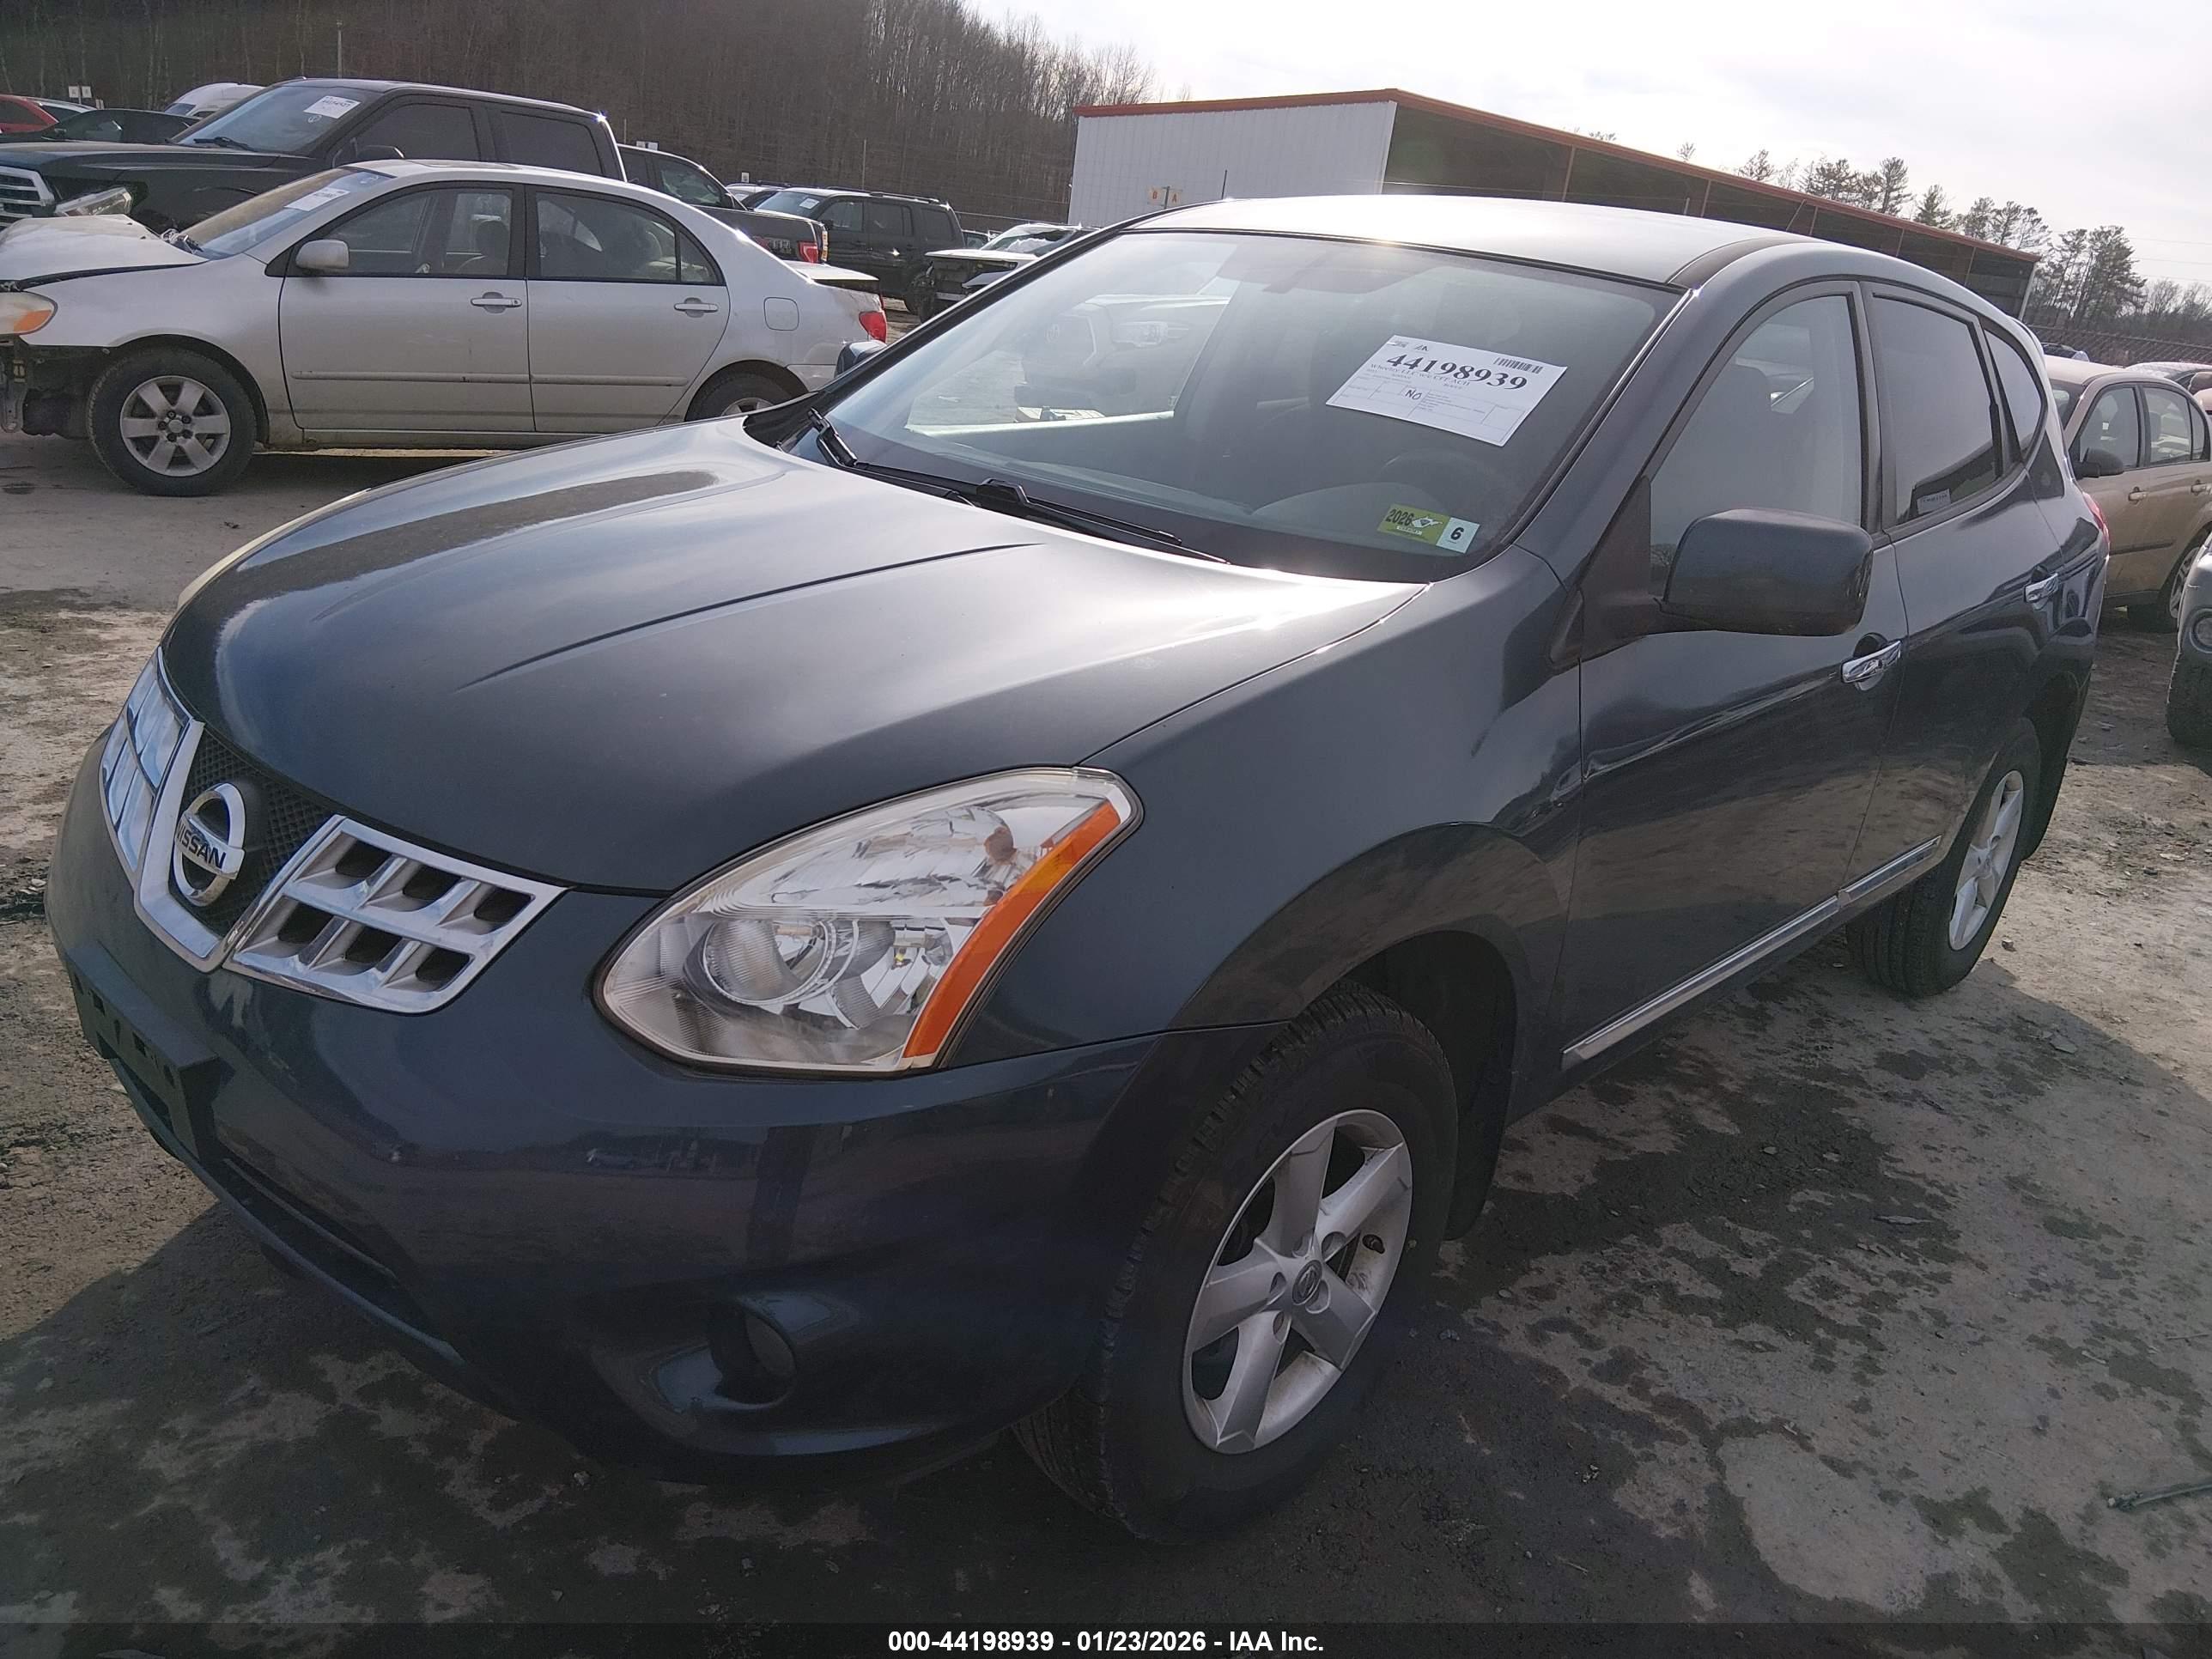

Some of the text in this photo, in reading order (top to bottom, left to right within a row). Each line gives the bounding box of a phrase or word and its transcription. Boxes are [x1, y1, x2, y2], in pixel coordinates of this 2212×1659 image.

[1387, 354, 1528, 390] 44198939
[1405, 389, 1423, 400] NO
[1385, 508, 1414, 526] 2026
[1450, 526, 1465, 541] 6
[176, 821, 227, 869] NISSAN
